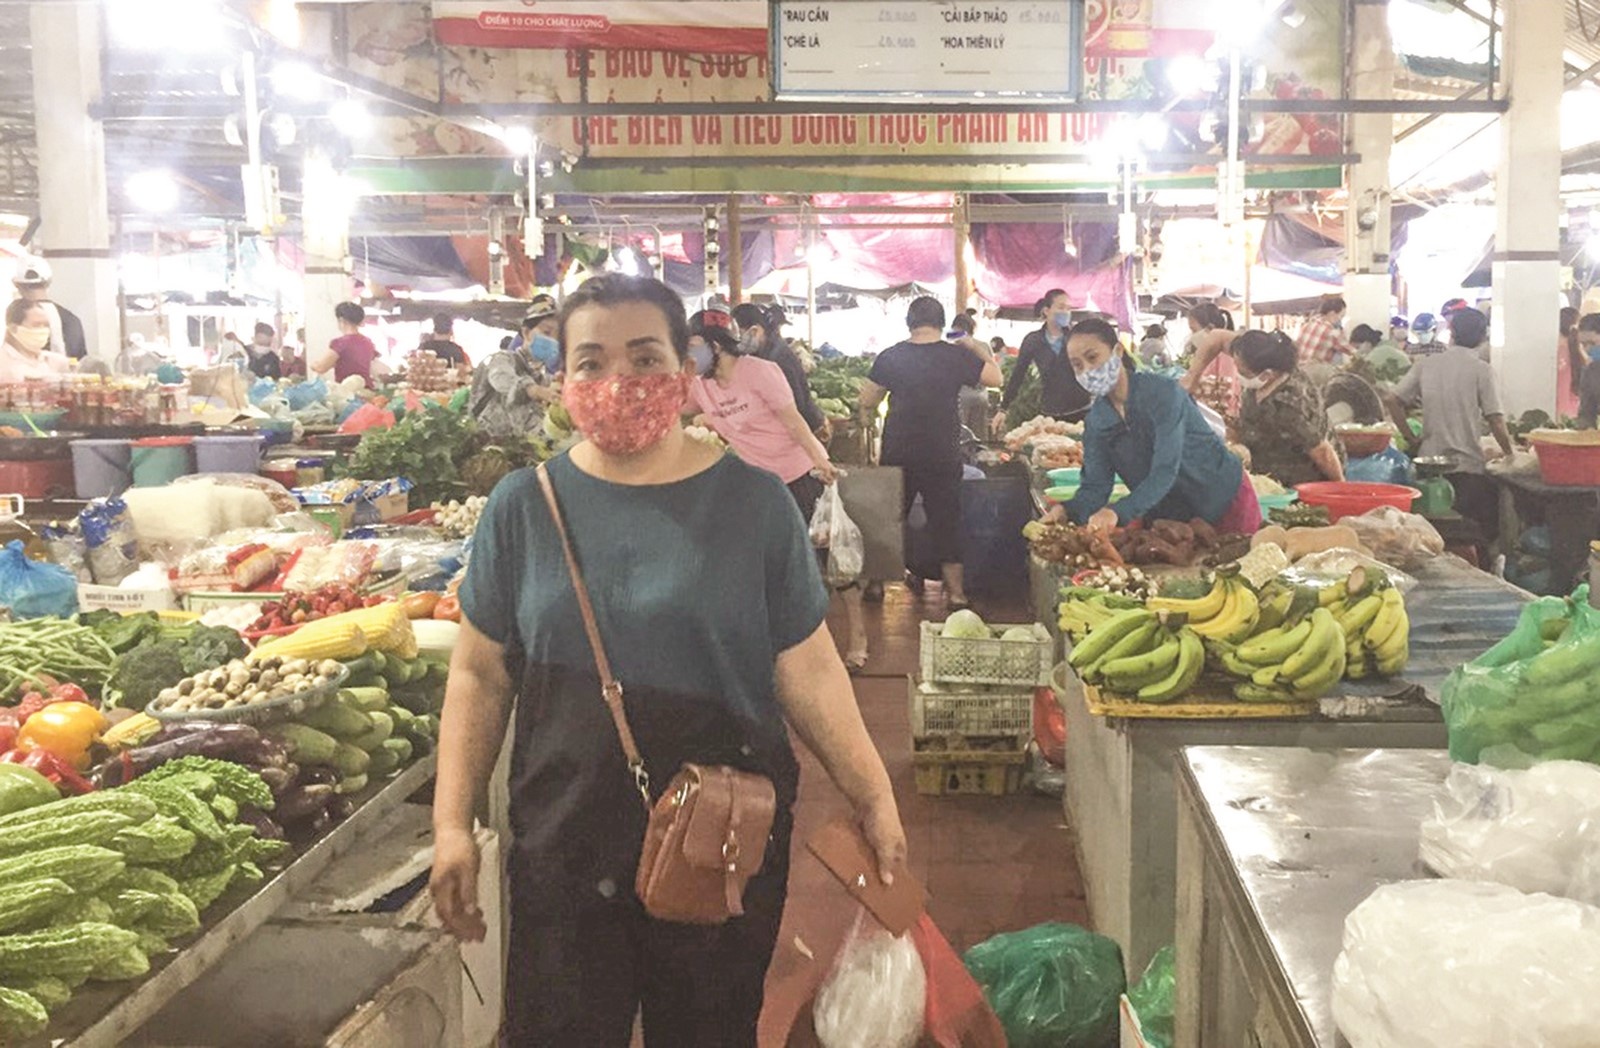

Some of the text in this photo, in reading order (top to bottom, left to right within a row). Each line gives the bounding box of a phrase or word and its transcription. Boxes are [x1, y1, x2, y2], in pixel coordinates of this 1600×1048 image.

[485, 14, 510, 25] ĐIỂM
[513, 17, 523, 25] 10
[524, 17, 545, 25] CHO
